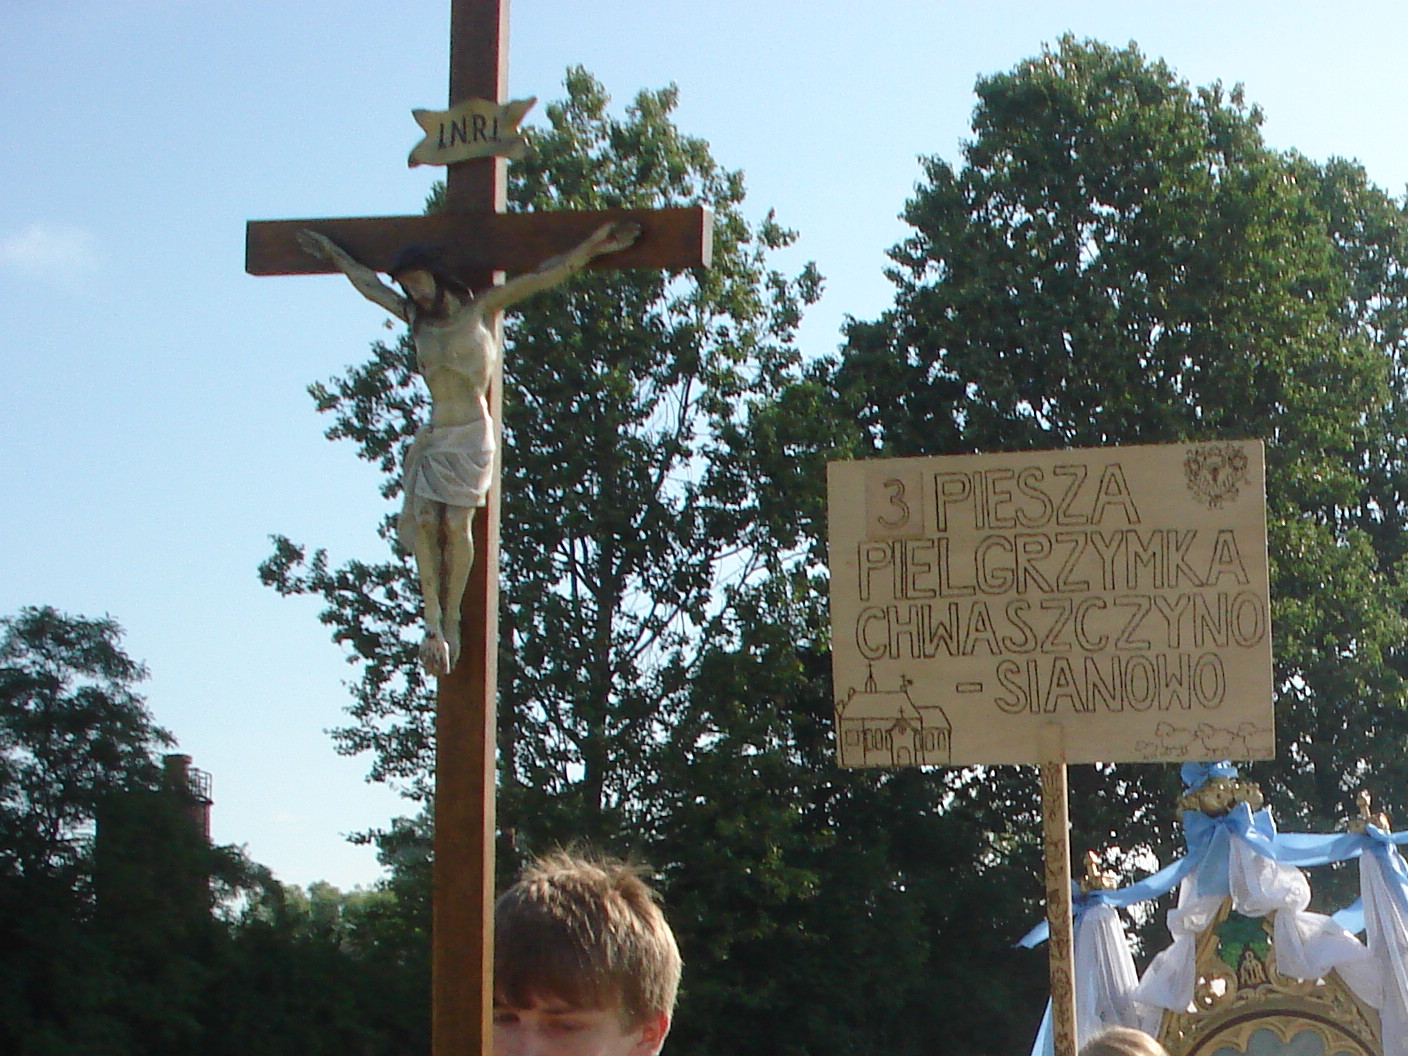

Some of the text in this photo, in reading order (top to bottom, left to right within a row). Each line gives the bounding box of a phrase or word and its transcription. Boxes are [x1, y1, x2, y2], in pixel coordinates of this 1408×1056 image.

[878, 463, 1141, 532] 3 PIESZA
[857, 530, 1250, 600] PIELGRZYMKA
[856, 592, 1266, 660] CHWASZCZYNO
[994, 652, 1226, 714] SIANOWO
